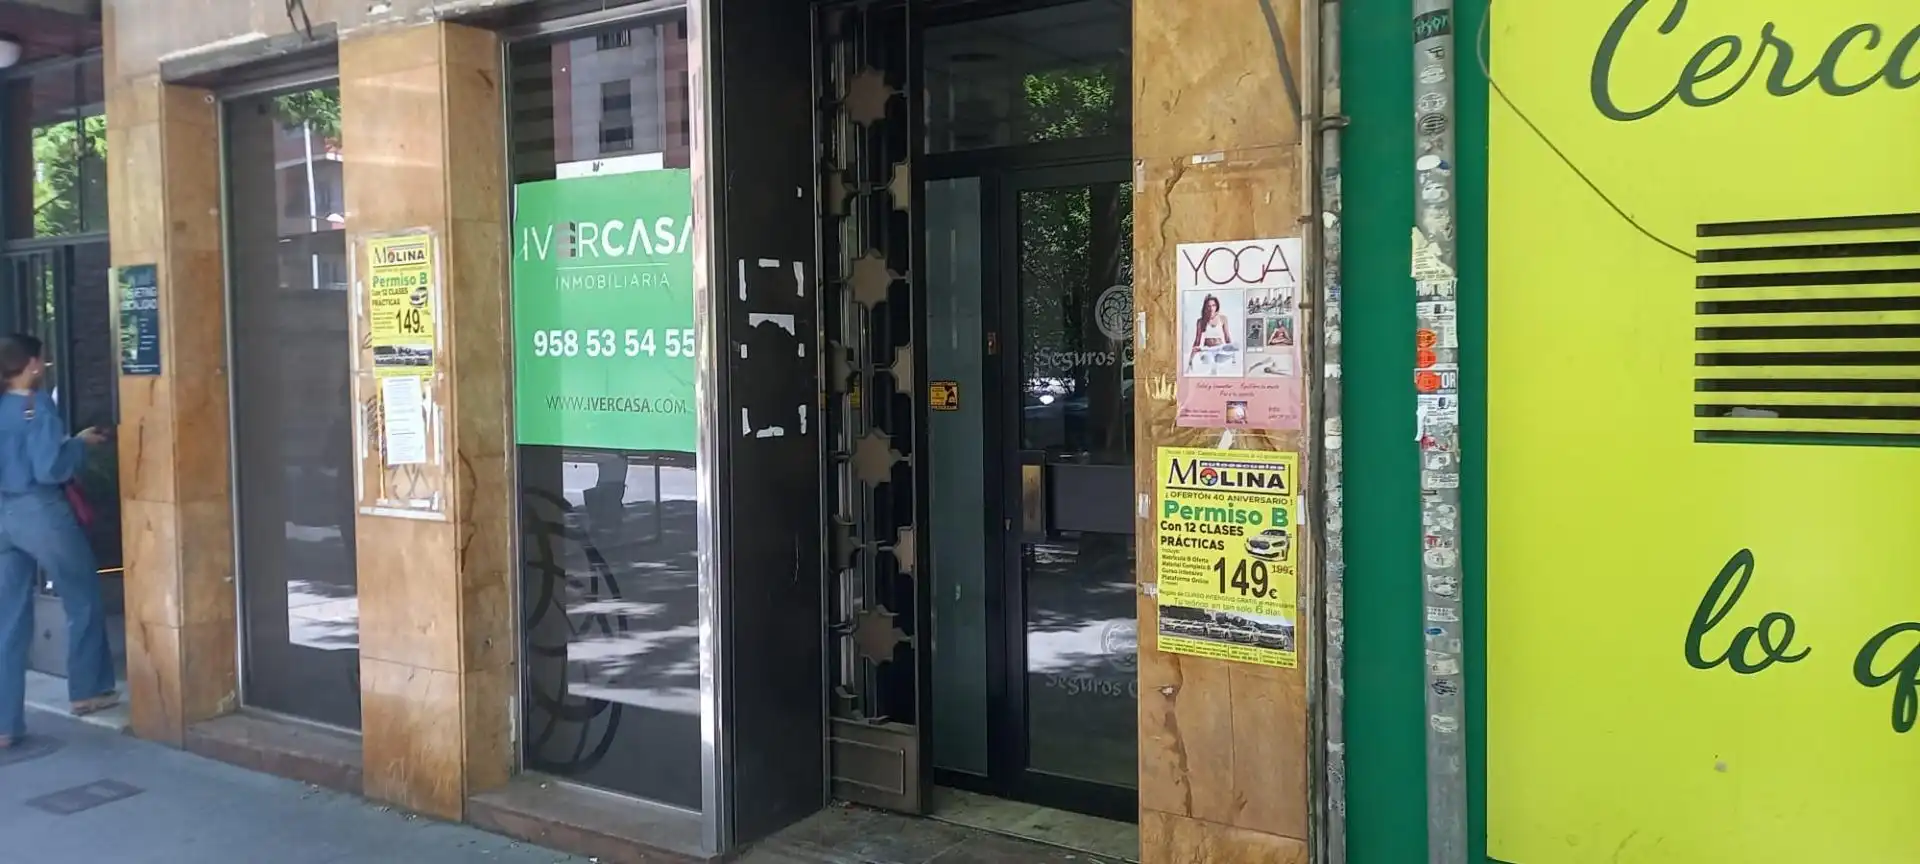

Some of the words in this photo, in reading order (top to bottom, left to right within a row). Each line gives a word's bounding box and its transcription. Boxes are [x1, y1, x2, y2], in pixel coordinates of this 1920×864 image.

[374, 247, 425, 264] MOLINA
[1183, 244, 1295, 285] YOGA
[372, 272, 416, 289] Permiso
[419, 272, 428, 285] B
[556, 272, 670, 290] INMOBILIARIA
[534, 329, 579, 357] 958
[586, 329, 616, 357] 53
[624, 329, 656, 357] 54
[665, 329, 695, 358] 55
[1041, 347, 1116, 371] Seguros
[546, 395, 687, 414] WWW.IVERCASA.COM
[1168, 458, 1285, 489] MOLINA
[1170, 490, 1211, 500] OFERTÓN
[1227, 495, 1288, 505] ANIVERSARIO
[1164, 500, 1263, 525] Permiso
[1272, 507, 1289, 527] B
[1160, 521, 1181, 531] Con
[1185, 522, 1196, 533] 12
[1200, 523, 1244, 536] CLASES
[1160, 535, 1225, 551] PRÁCTICAS
[1256, 604, 1264, 614] 6
[1685, 548, 1812, 674] lo
